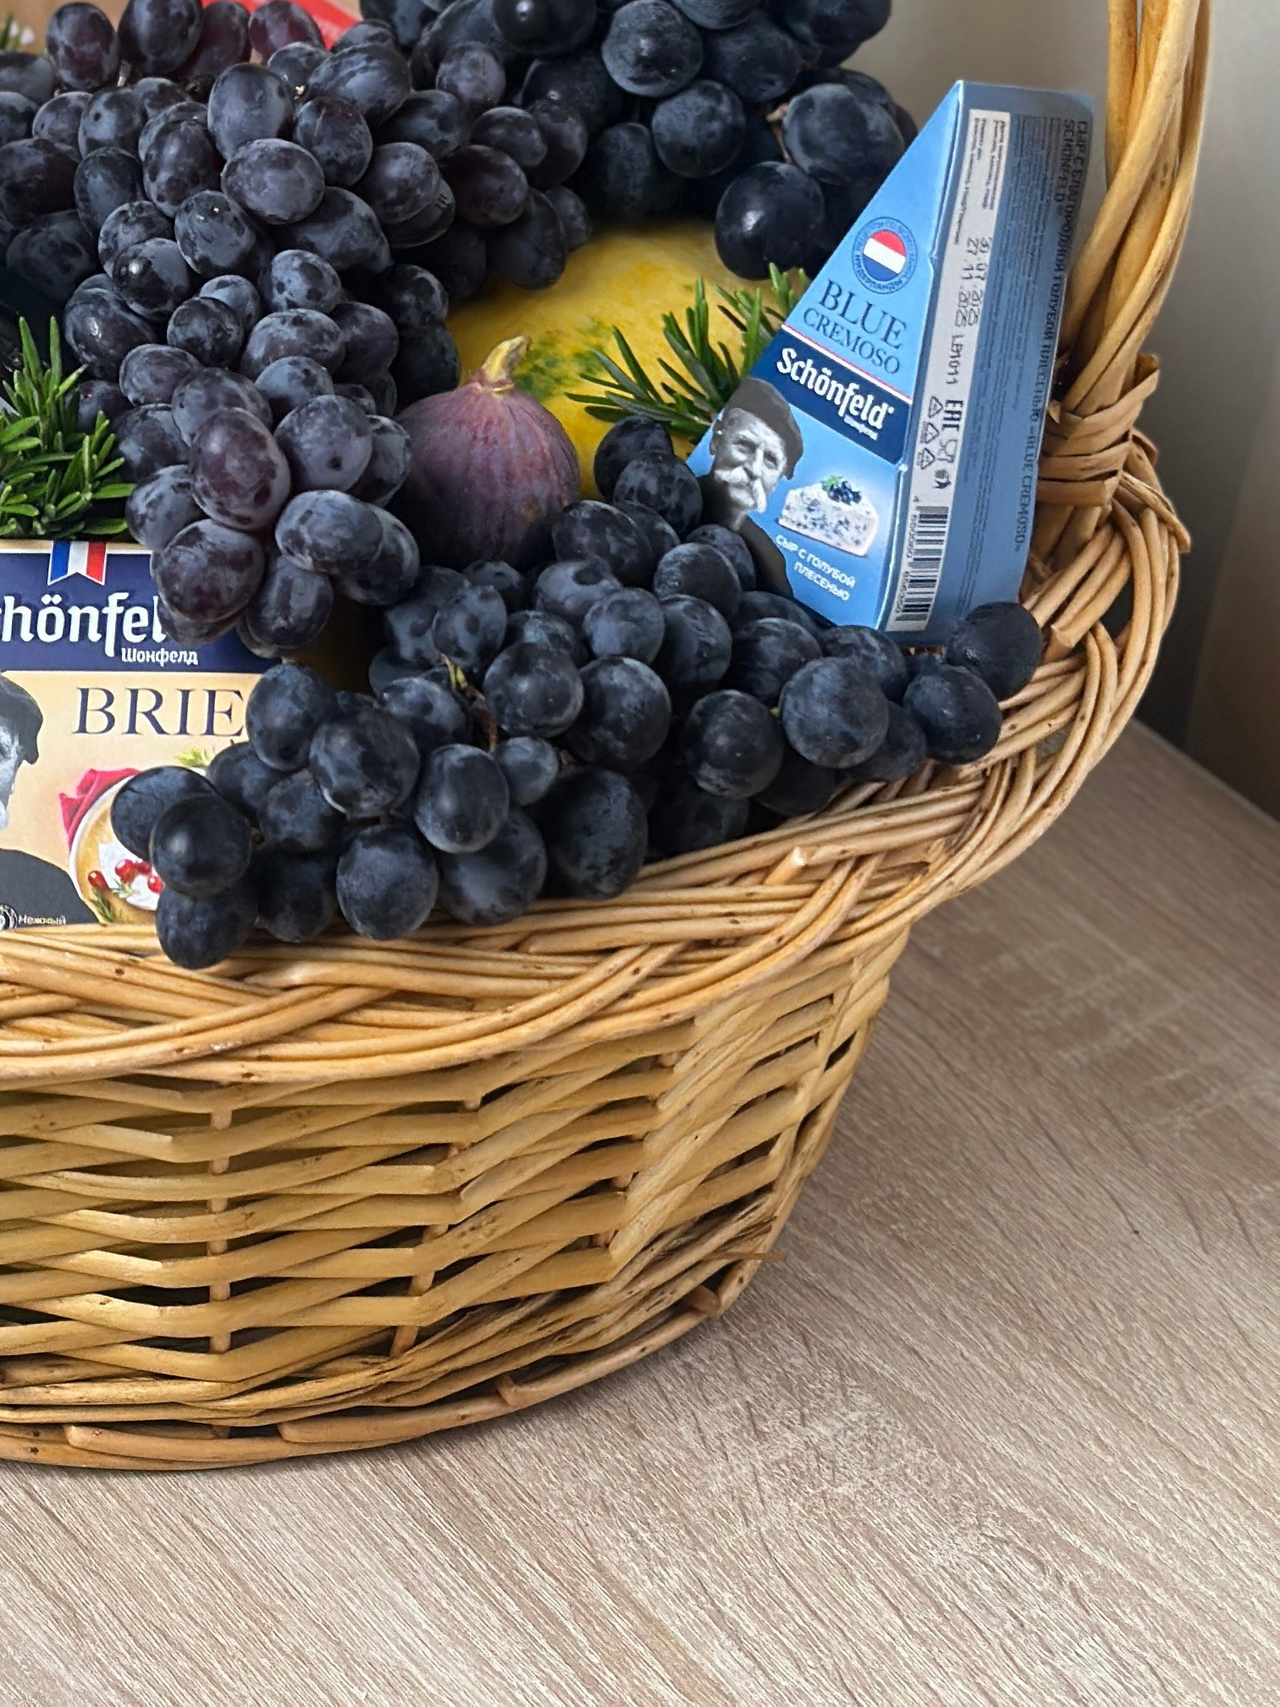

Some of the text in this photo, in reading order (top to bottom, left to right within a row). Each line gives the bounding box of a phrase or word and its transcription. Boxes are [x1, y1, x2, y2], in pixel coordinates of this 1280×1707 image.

[803, 307, 901, 375] CREMOSO
[818, 279, 907, 349] BLUE
[121, 647, 198, 667] Шонфелд
[72, 686, 247, 736] BRIE
